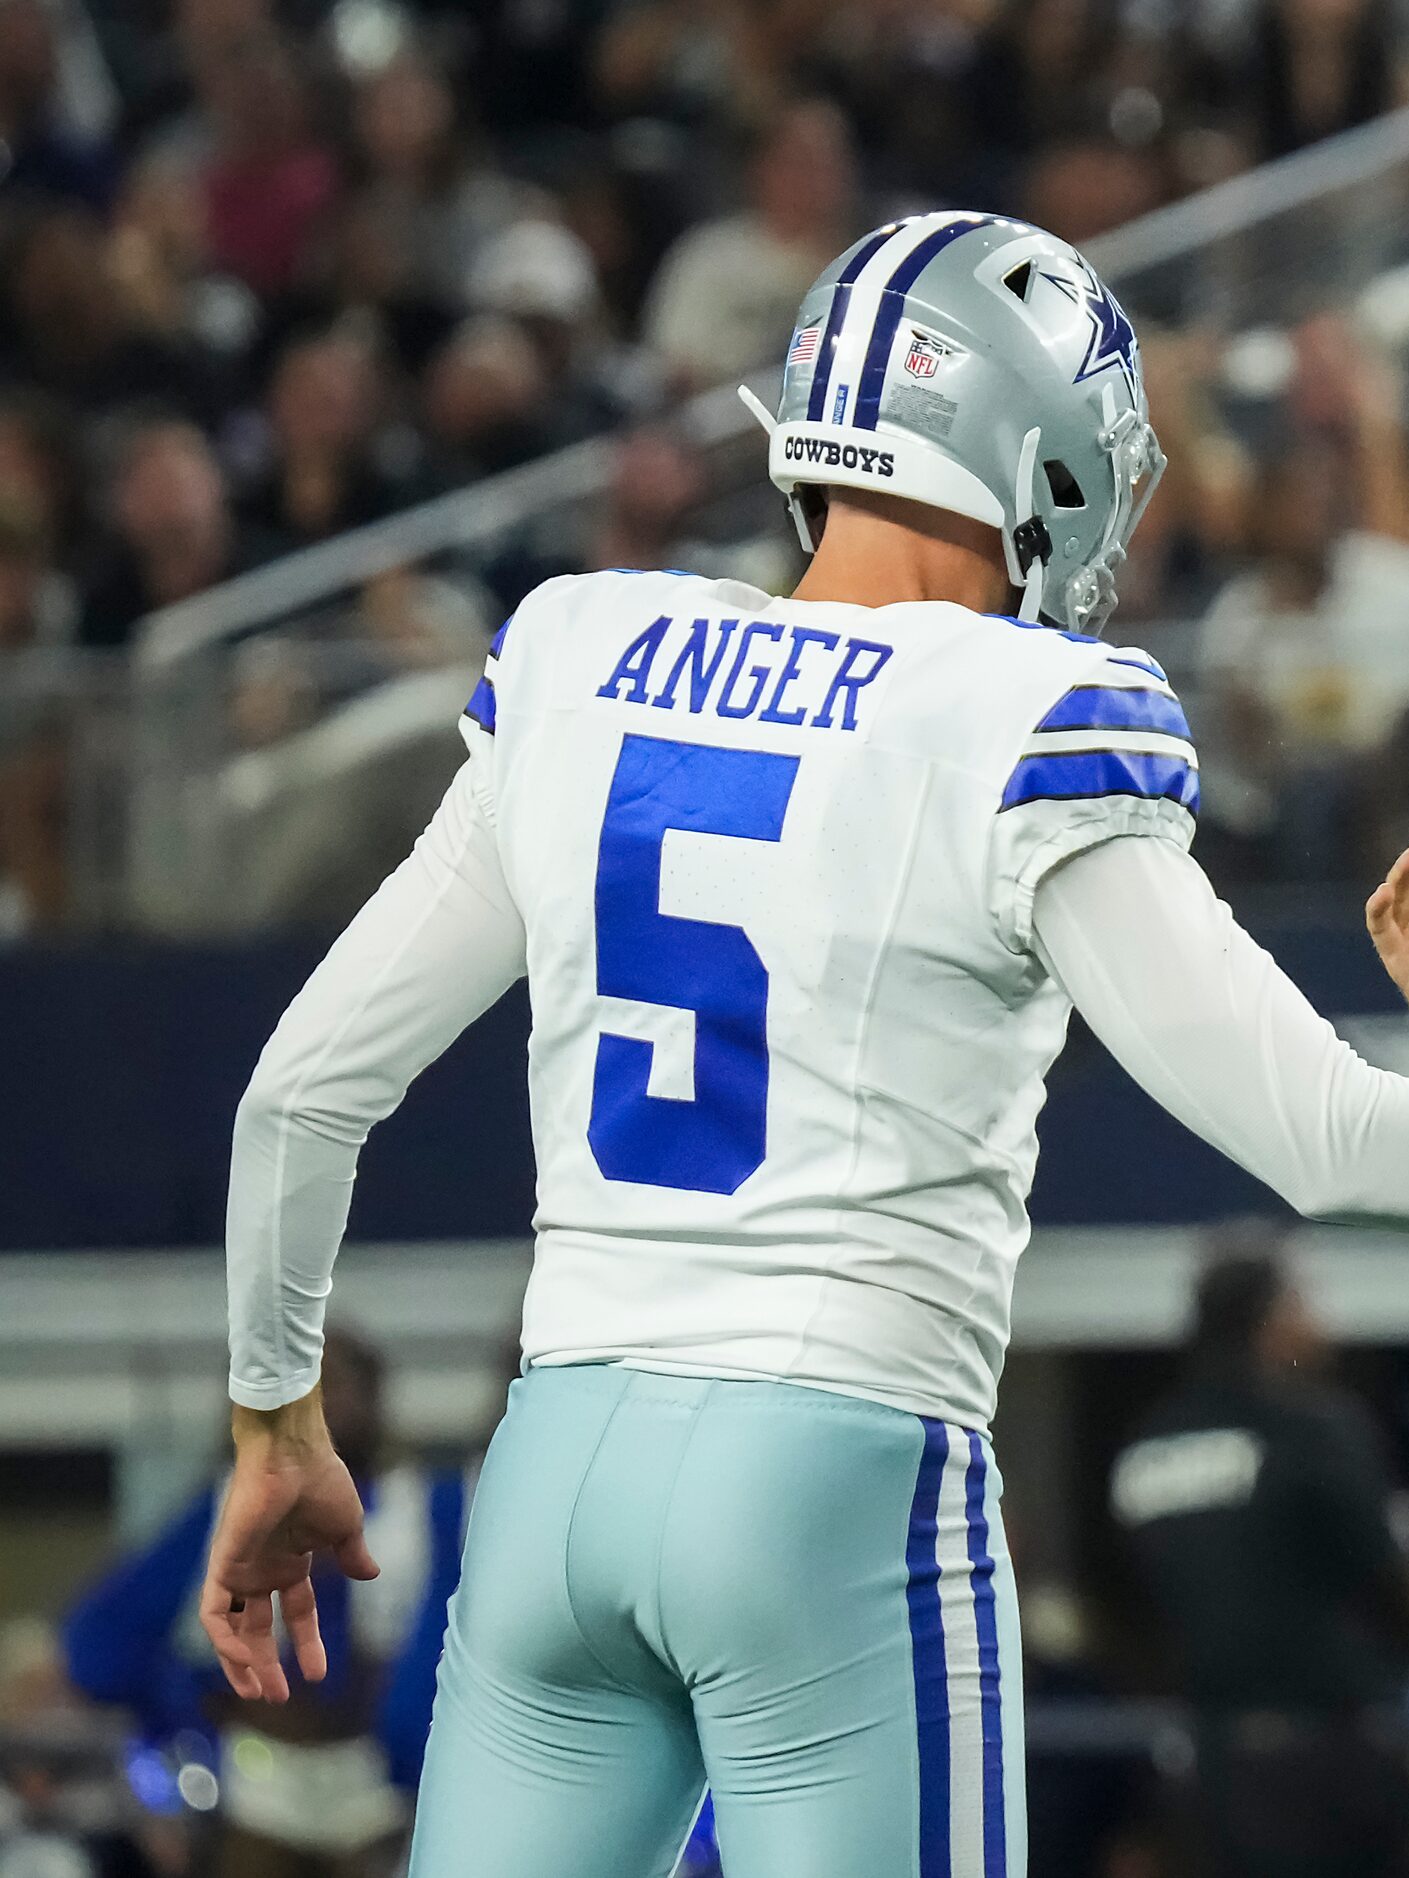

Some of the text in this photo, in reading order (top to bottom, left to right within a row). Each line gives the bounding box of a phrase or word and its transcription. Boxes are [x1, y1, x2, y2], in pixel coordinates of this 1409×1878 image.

[907, 353, 933, 375] NFL
[785, 436, 894, 477] COWBOYS
[595, 615, 894, 731] ANGER
[586, 733, 802, 1196] 5
